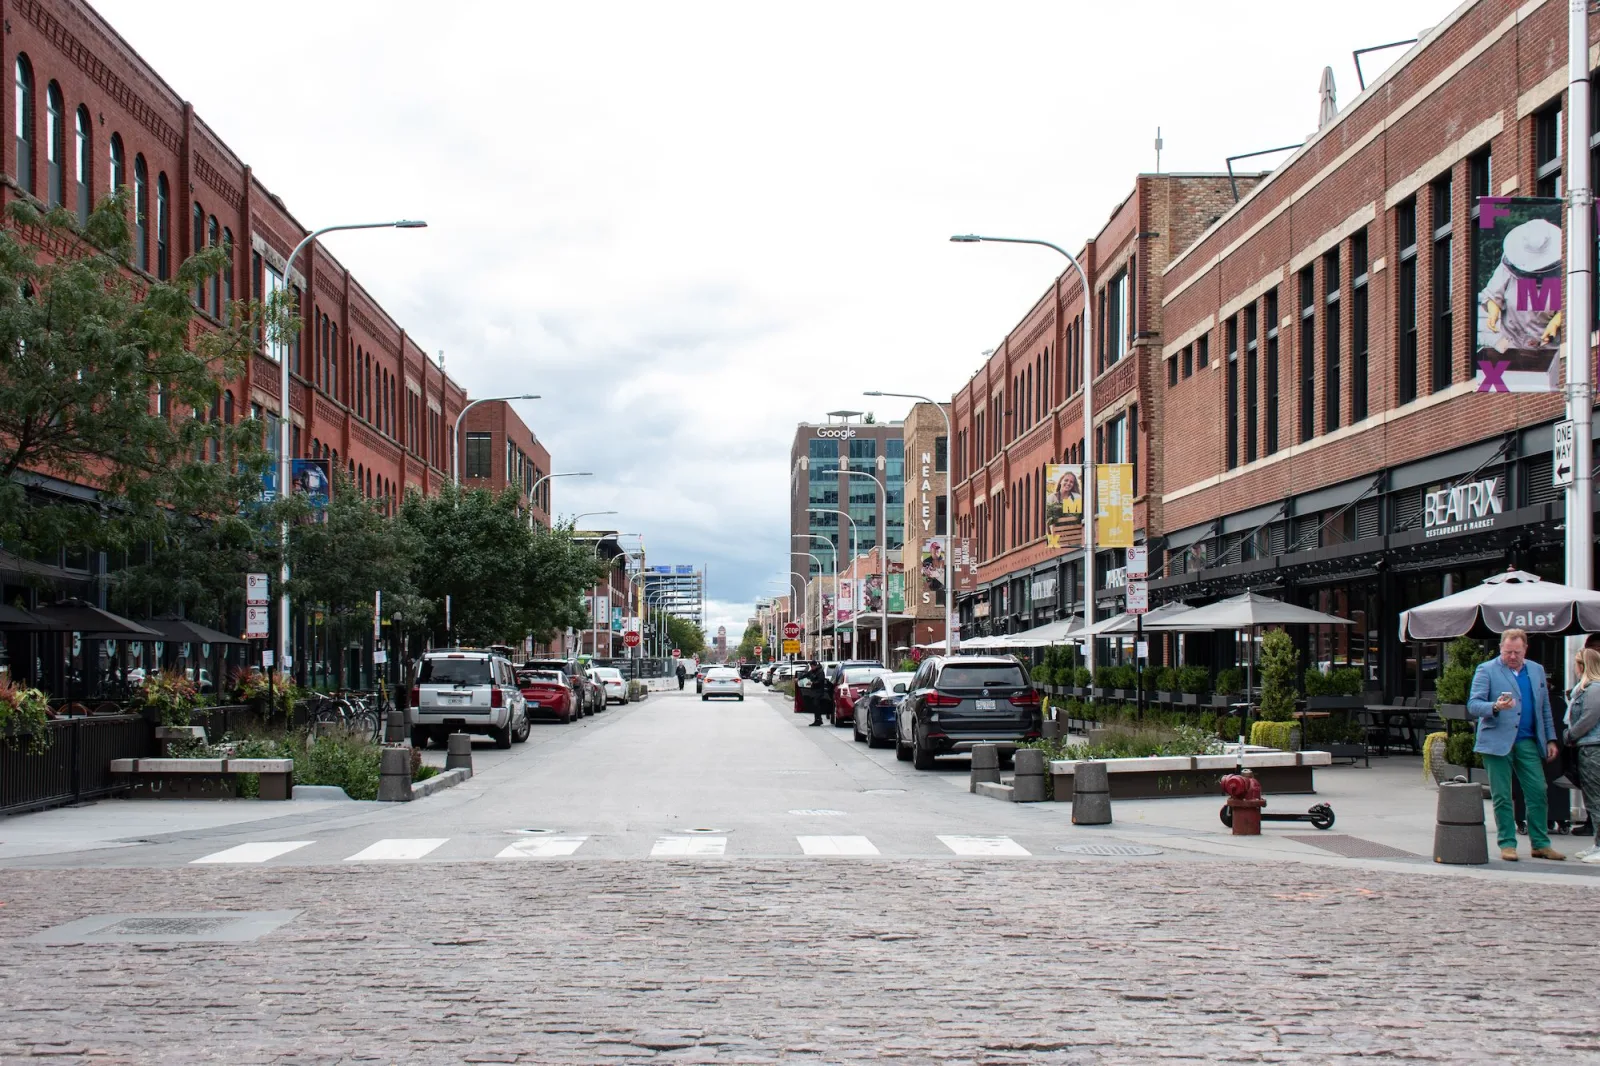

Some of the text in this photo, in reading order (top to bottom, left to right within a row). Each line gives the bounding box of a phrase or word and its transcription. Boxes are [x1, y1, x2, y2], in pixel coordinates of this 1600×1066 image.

[1479, 197, 1511, 228] F
[1516, 278, 1561, 311] M
[1477, 360, 1510, 392] X
[816, 426, 856, 440] Google
[1556, 425, 1572, 443] ONE
[1556, 442, 1572, 461] WAY
[921, 452, 931, 531] NEALEY
[1062, 498, 1082, 513] M
[1425, 476, 1504, 527] BEATRIX
[1426, 523, 1462, 538] RESTAURANT
[1469, 518, 1494, 531] MARKET
[1499, 611, 1556, 627] Valet
[625, 635, 640, 643] STOP
